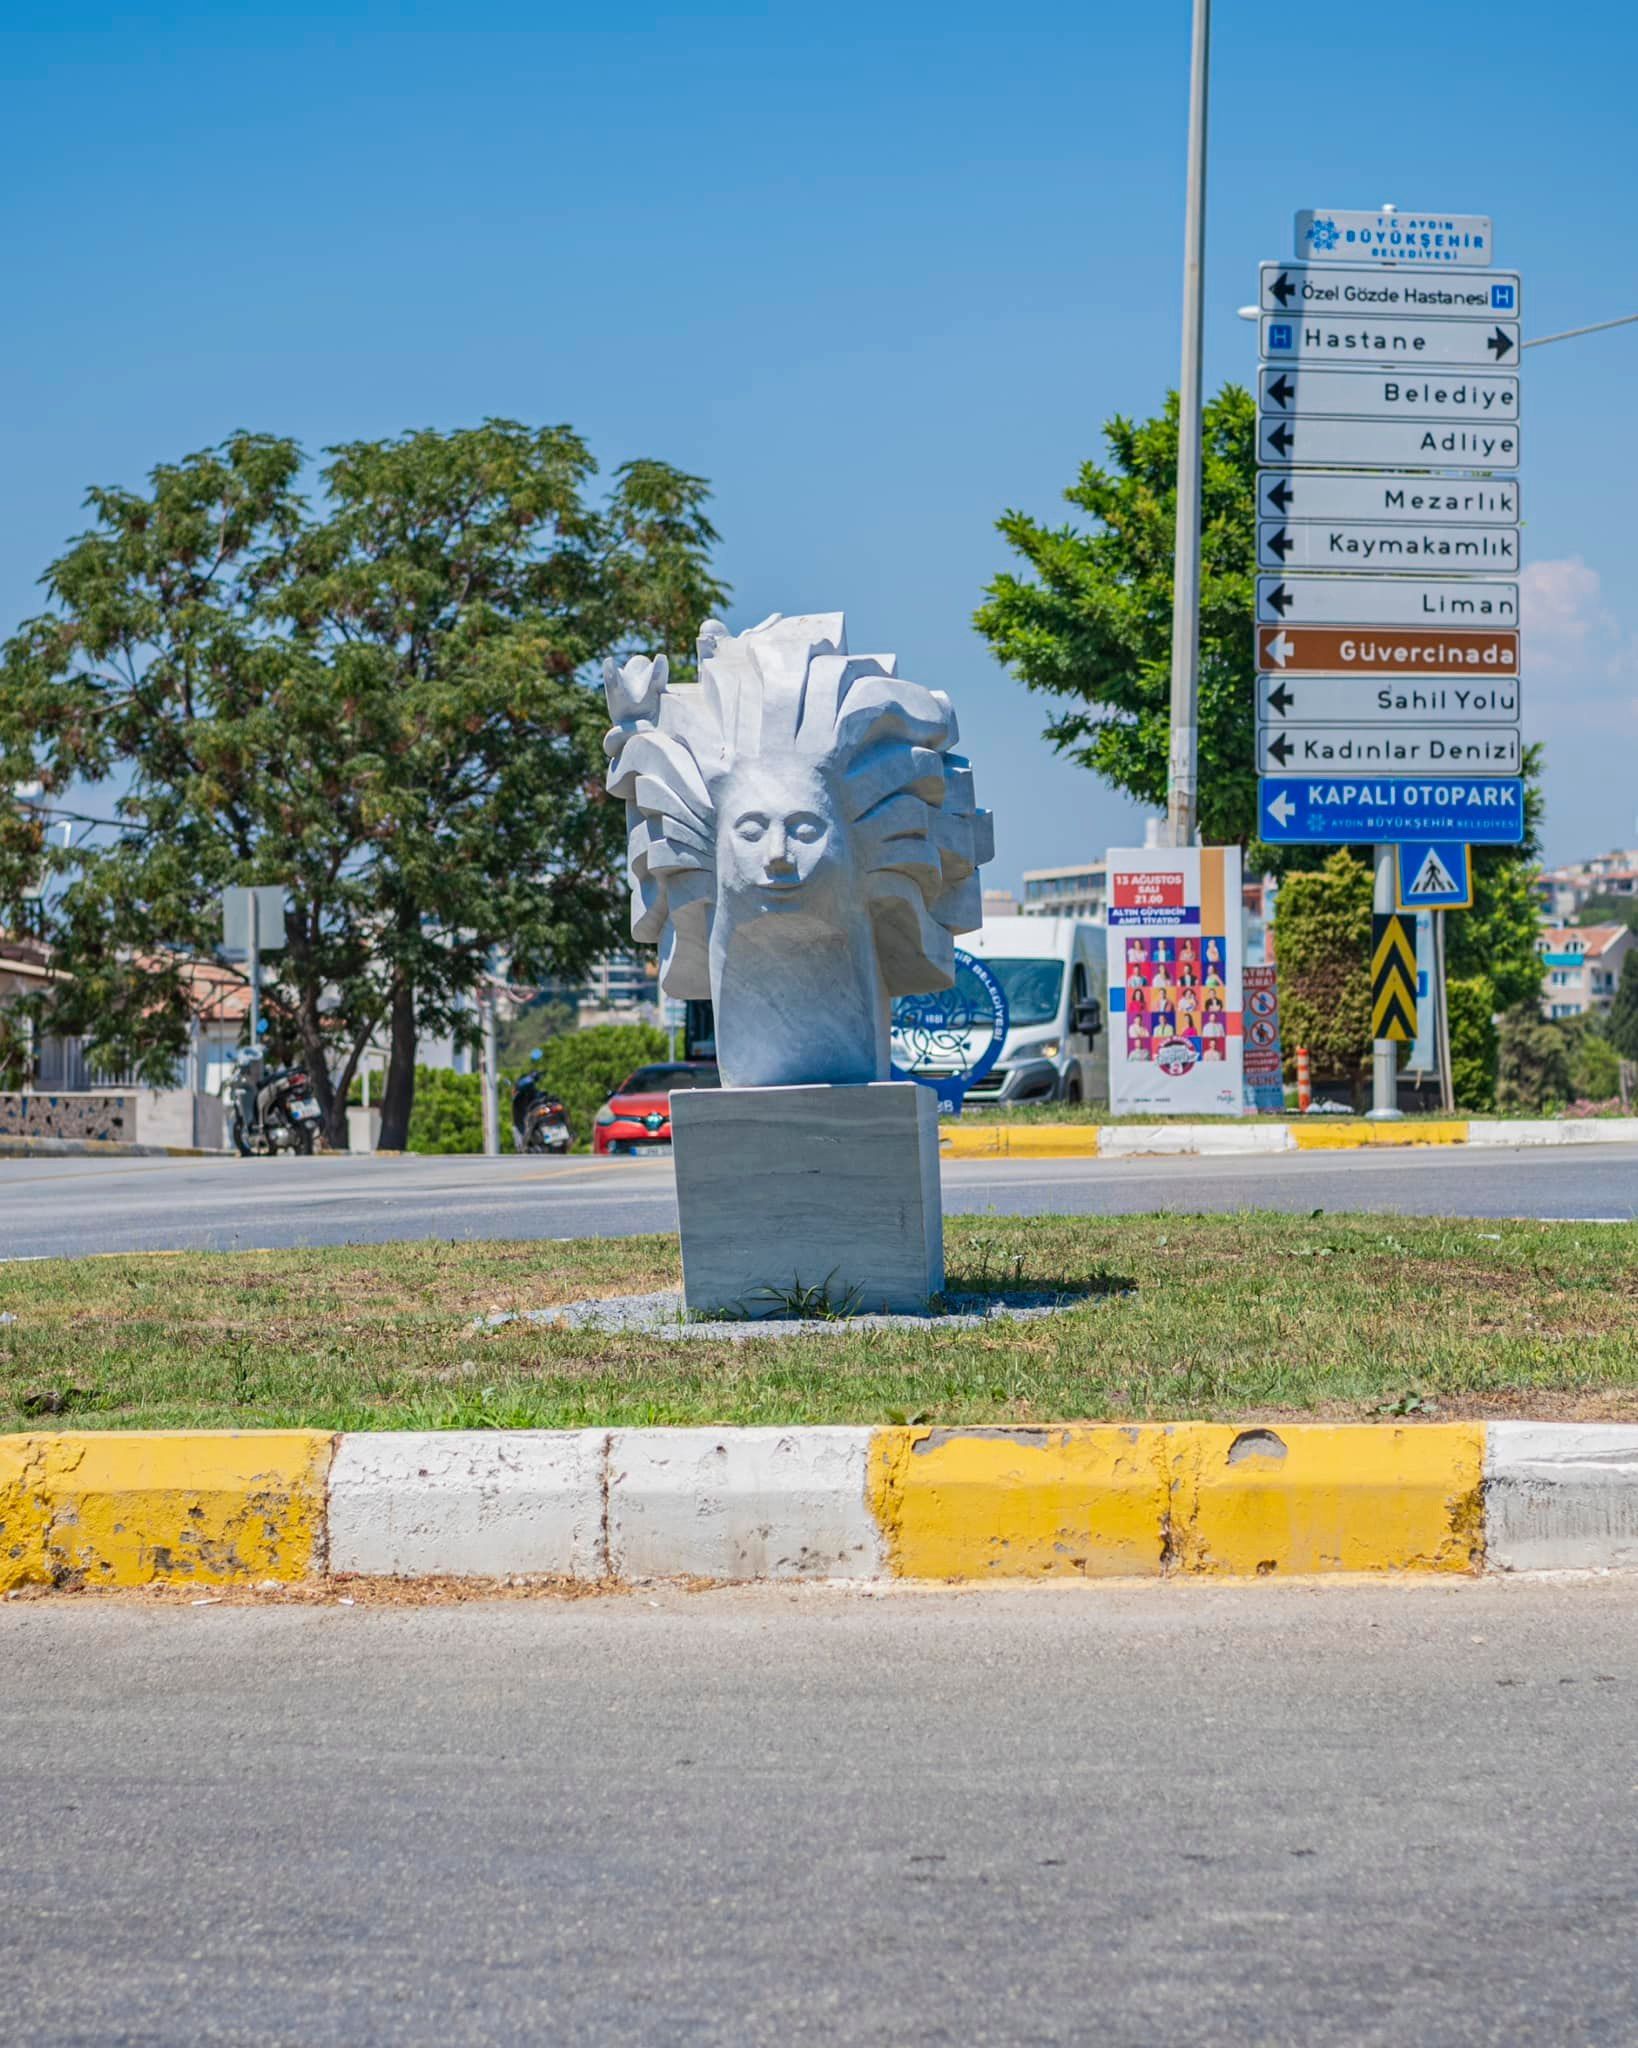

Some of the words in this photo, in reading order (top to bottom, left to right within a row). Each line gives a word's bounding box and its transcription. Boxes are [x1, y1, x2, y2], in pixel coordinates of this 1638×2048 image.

[1409, 219, 1454, 231] AYDIN
[1346, 229, 1484, 249] BÜYÜKŞEHİR
[1371, 248, 1458, 261] BELEDİYESİ
[1301, 280, 1339, 301] Özel
[1344, 285, 1399, 303] Gözde
[1404, 288, 1489, 306] Hastanesi
[1305, 328, 1426, 351] Hastane
[1384, 383, 1514, 410] Belediye
[1420, 432, 1514, 457] Adliye
[1385, 490, 1513, 512] Mezarlık
[1330, 533, 1513, 558] Kaymakamlık
[1423, 594, 1513, 614] Liman
[1339, 640, 1514, 665] Güvercinada
[1377, 690, 1447, 710] Sahil
[1455, 690, 1514, 710] Yolu
[1304, 740, 1421, 760] Kadınlar
[1430, 740, 1515, 760] Denizi
[1308, 785, 1396, 806] KAPALI
[1403, 786, 1516, 807] OTOPARK
[1367, 816, 1454, 829] BÜYÜKŞEHİR
[1131, 874, 1182, 886] AĞUSTOS
